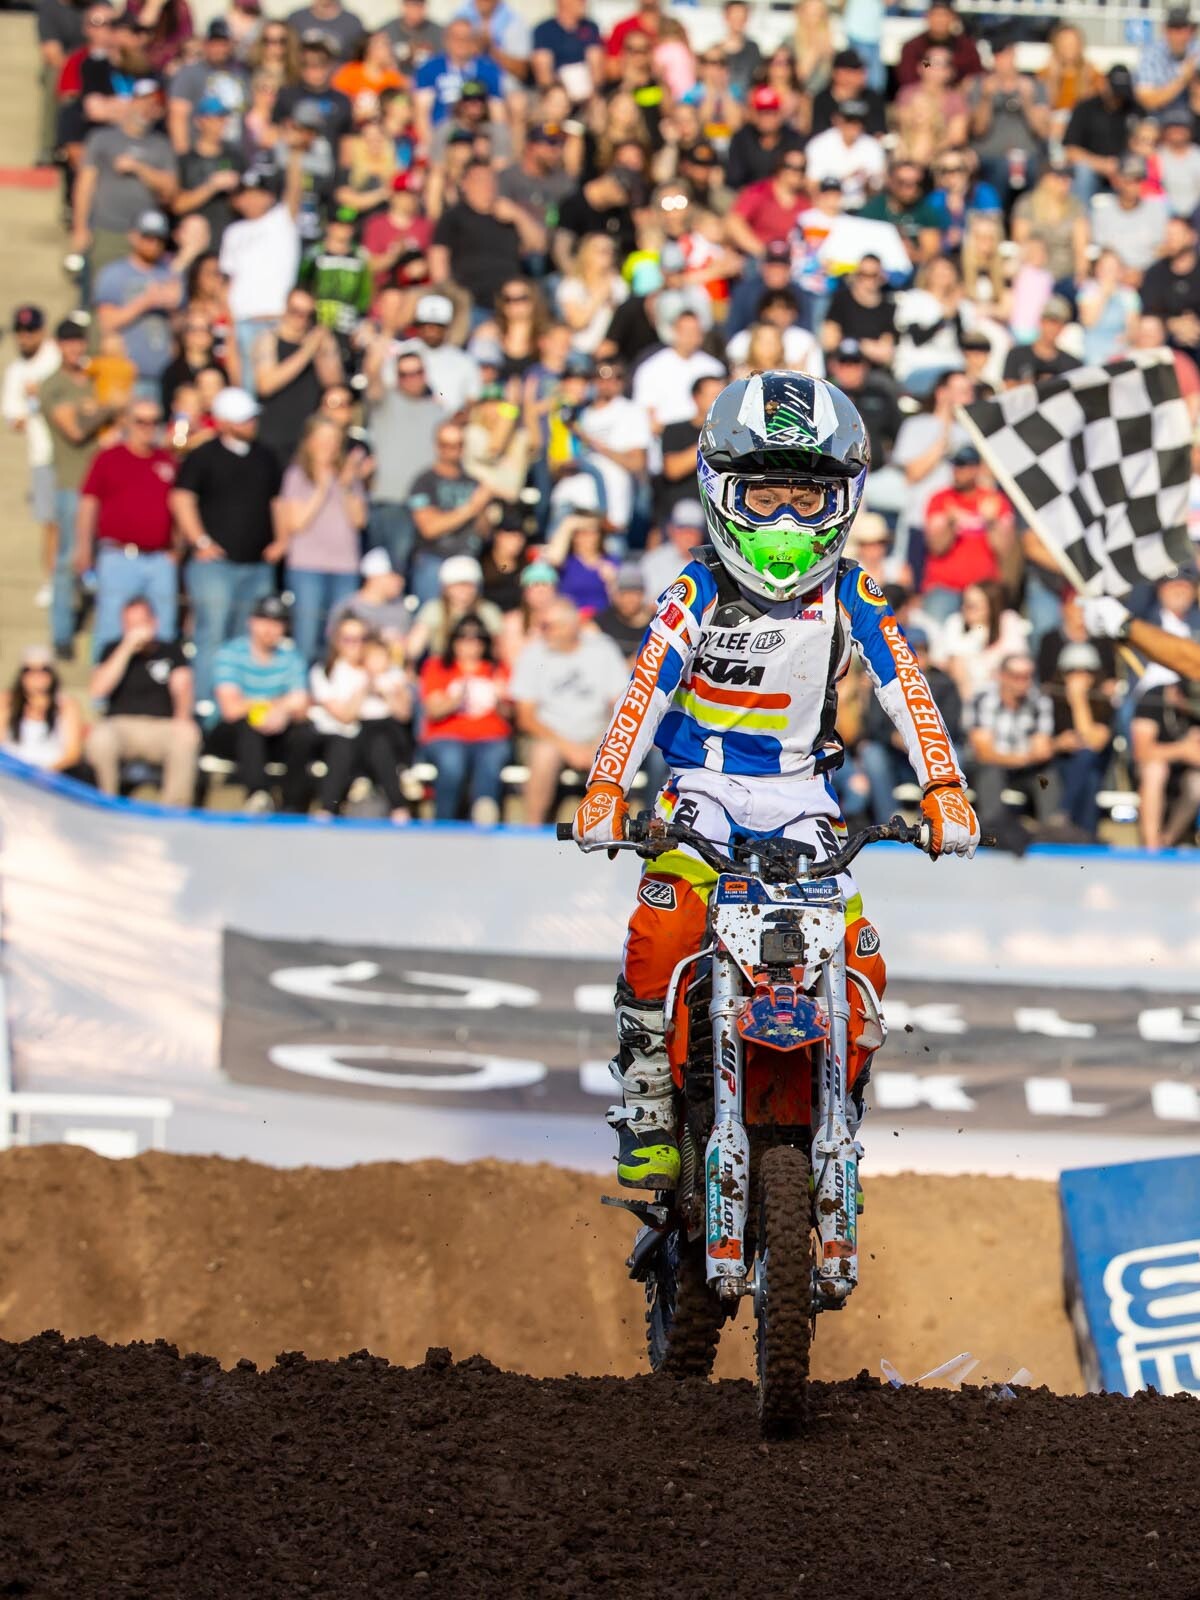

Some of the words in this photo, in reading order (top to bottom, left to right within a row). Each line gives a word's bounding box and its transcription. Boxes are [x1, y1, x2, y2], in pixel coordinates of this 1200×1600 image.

[637, 632, 668, 684] TROY
[716, 633, 751, 650] LEE
[692, 653, 766, 686] KTM
[884, 625, 930, 701] DESIGNS
[624, 677, 651, 716] LEE
[911, 704, 942, 735] LEE
[673, 798, 700, 828] KT
[724, 1161, 734, 1238] DLOP
[834, 1161, 844, 1238] DULOP
